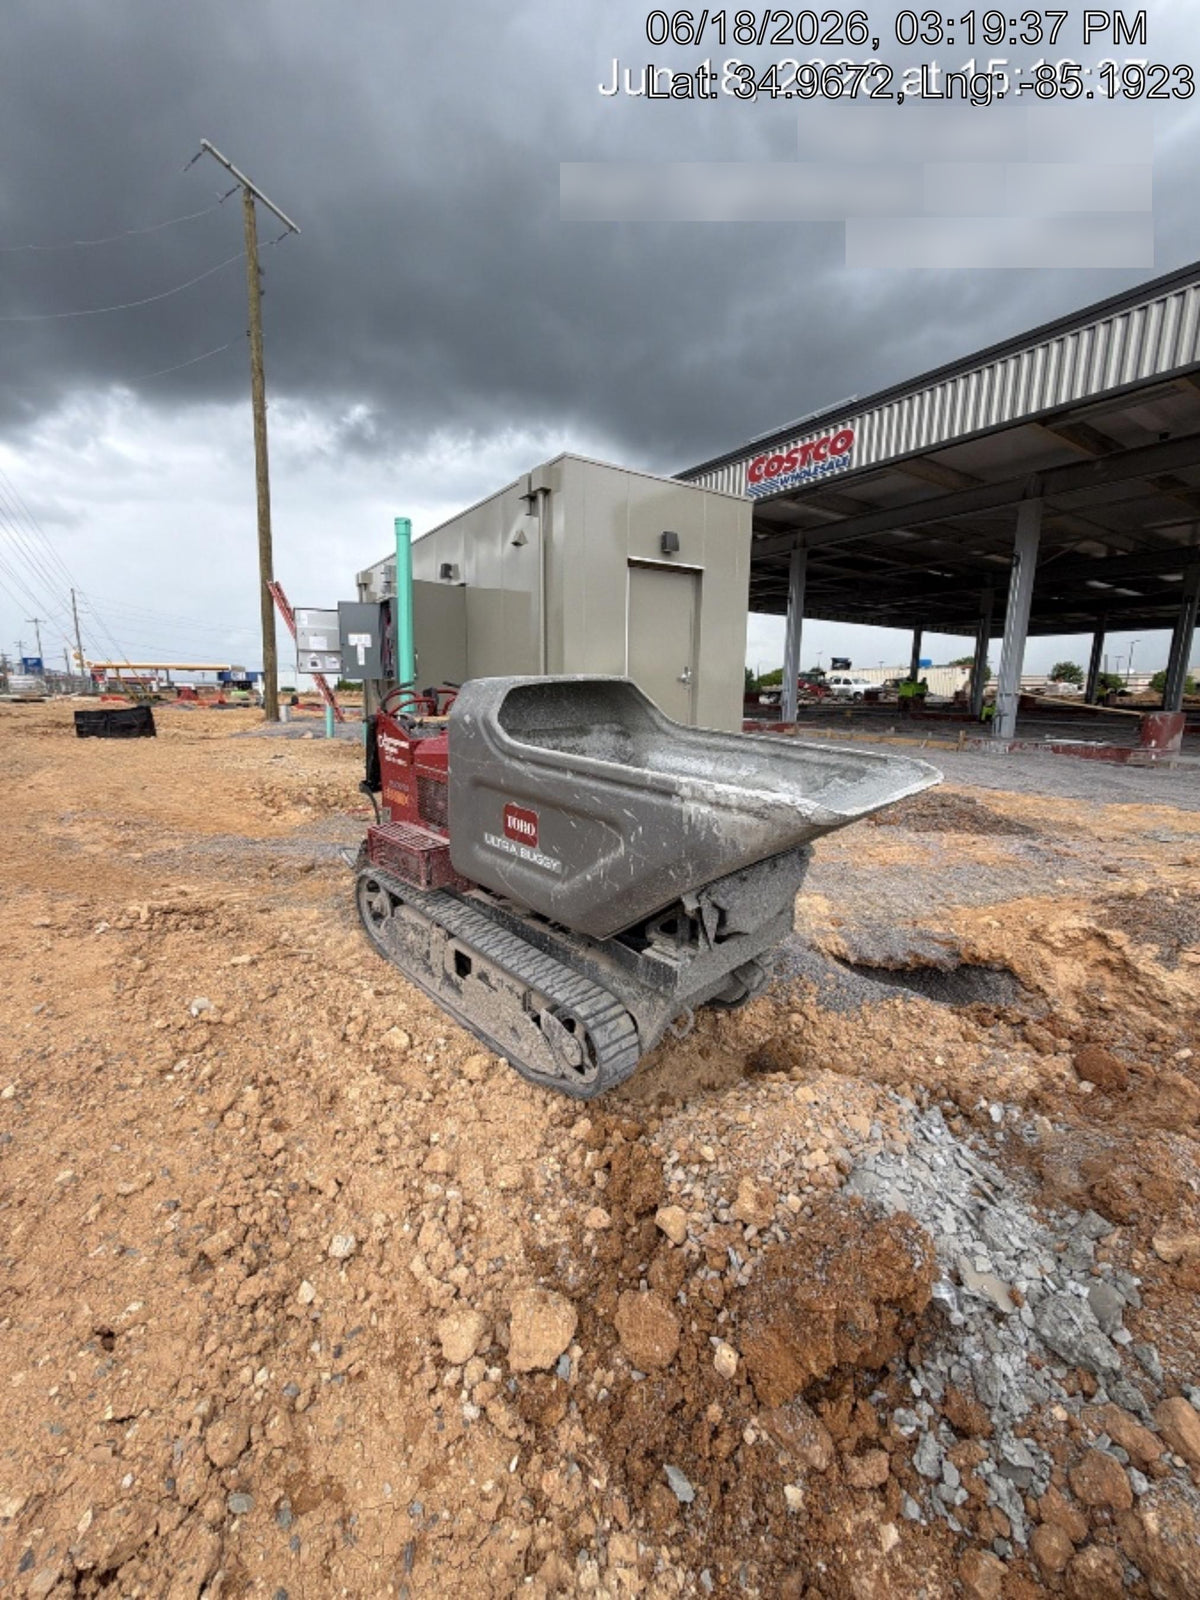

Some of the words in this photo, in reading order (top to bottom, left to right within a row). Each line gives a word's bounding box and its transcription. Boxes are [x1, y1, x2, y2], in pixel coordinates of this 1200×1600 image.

[748, 430, 854, 482] COSTCO
[780, 455, 849, 485] WHOLESALE
[507, 814, 536, 837] TORO
[484, 832, 518, 856] ULTRA
[520, 847, 562, 874] BUGGY
